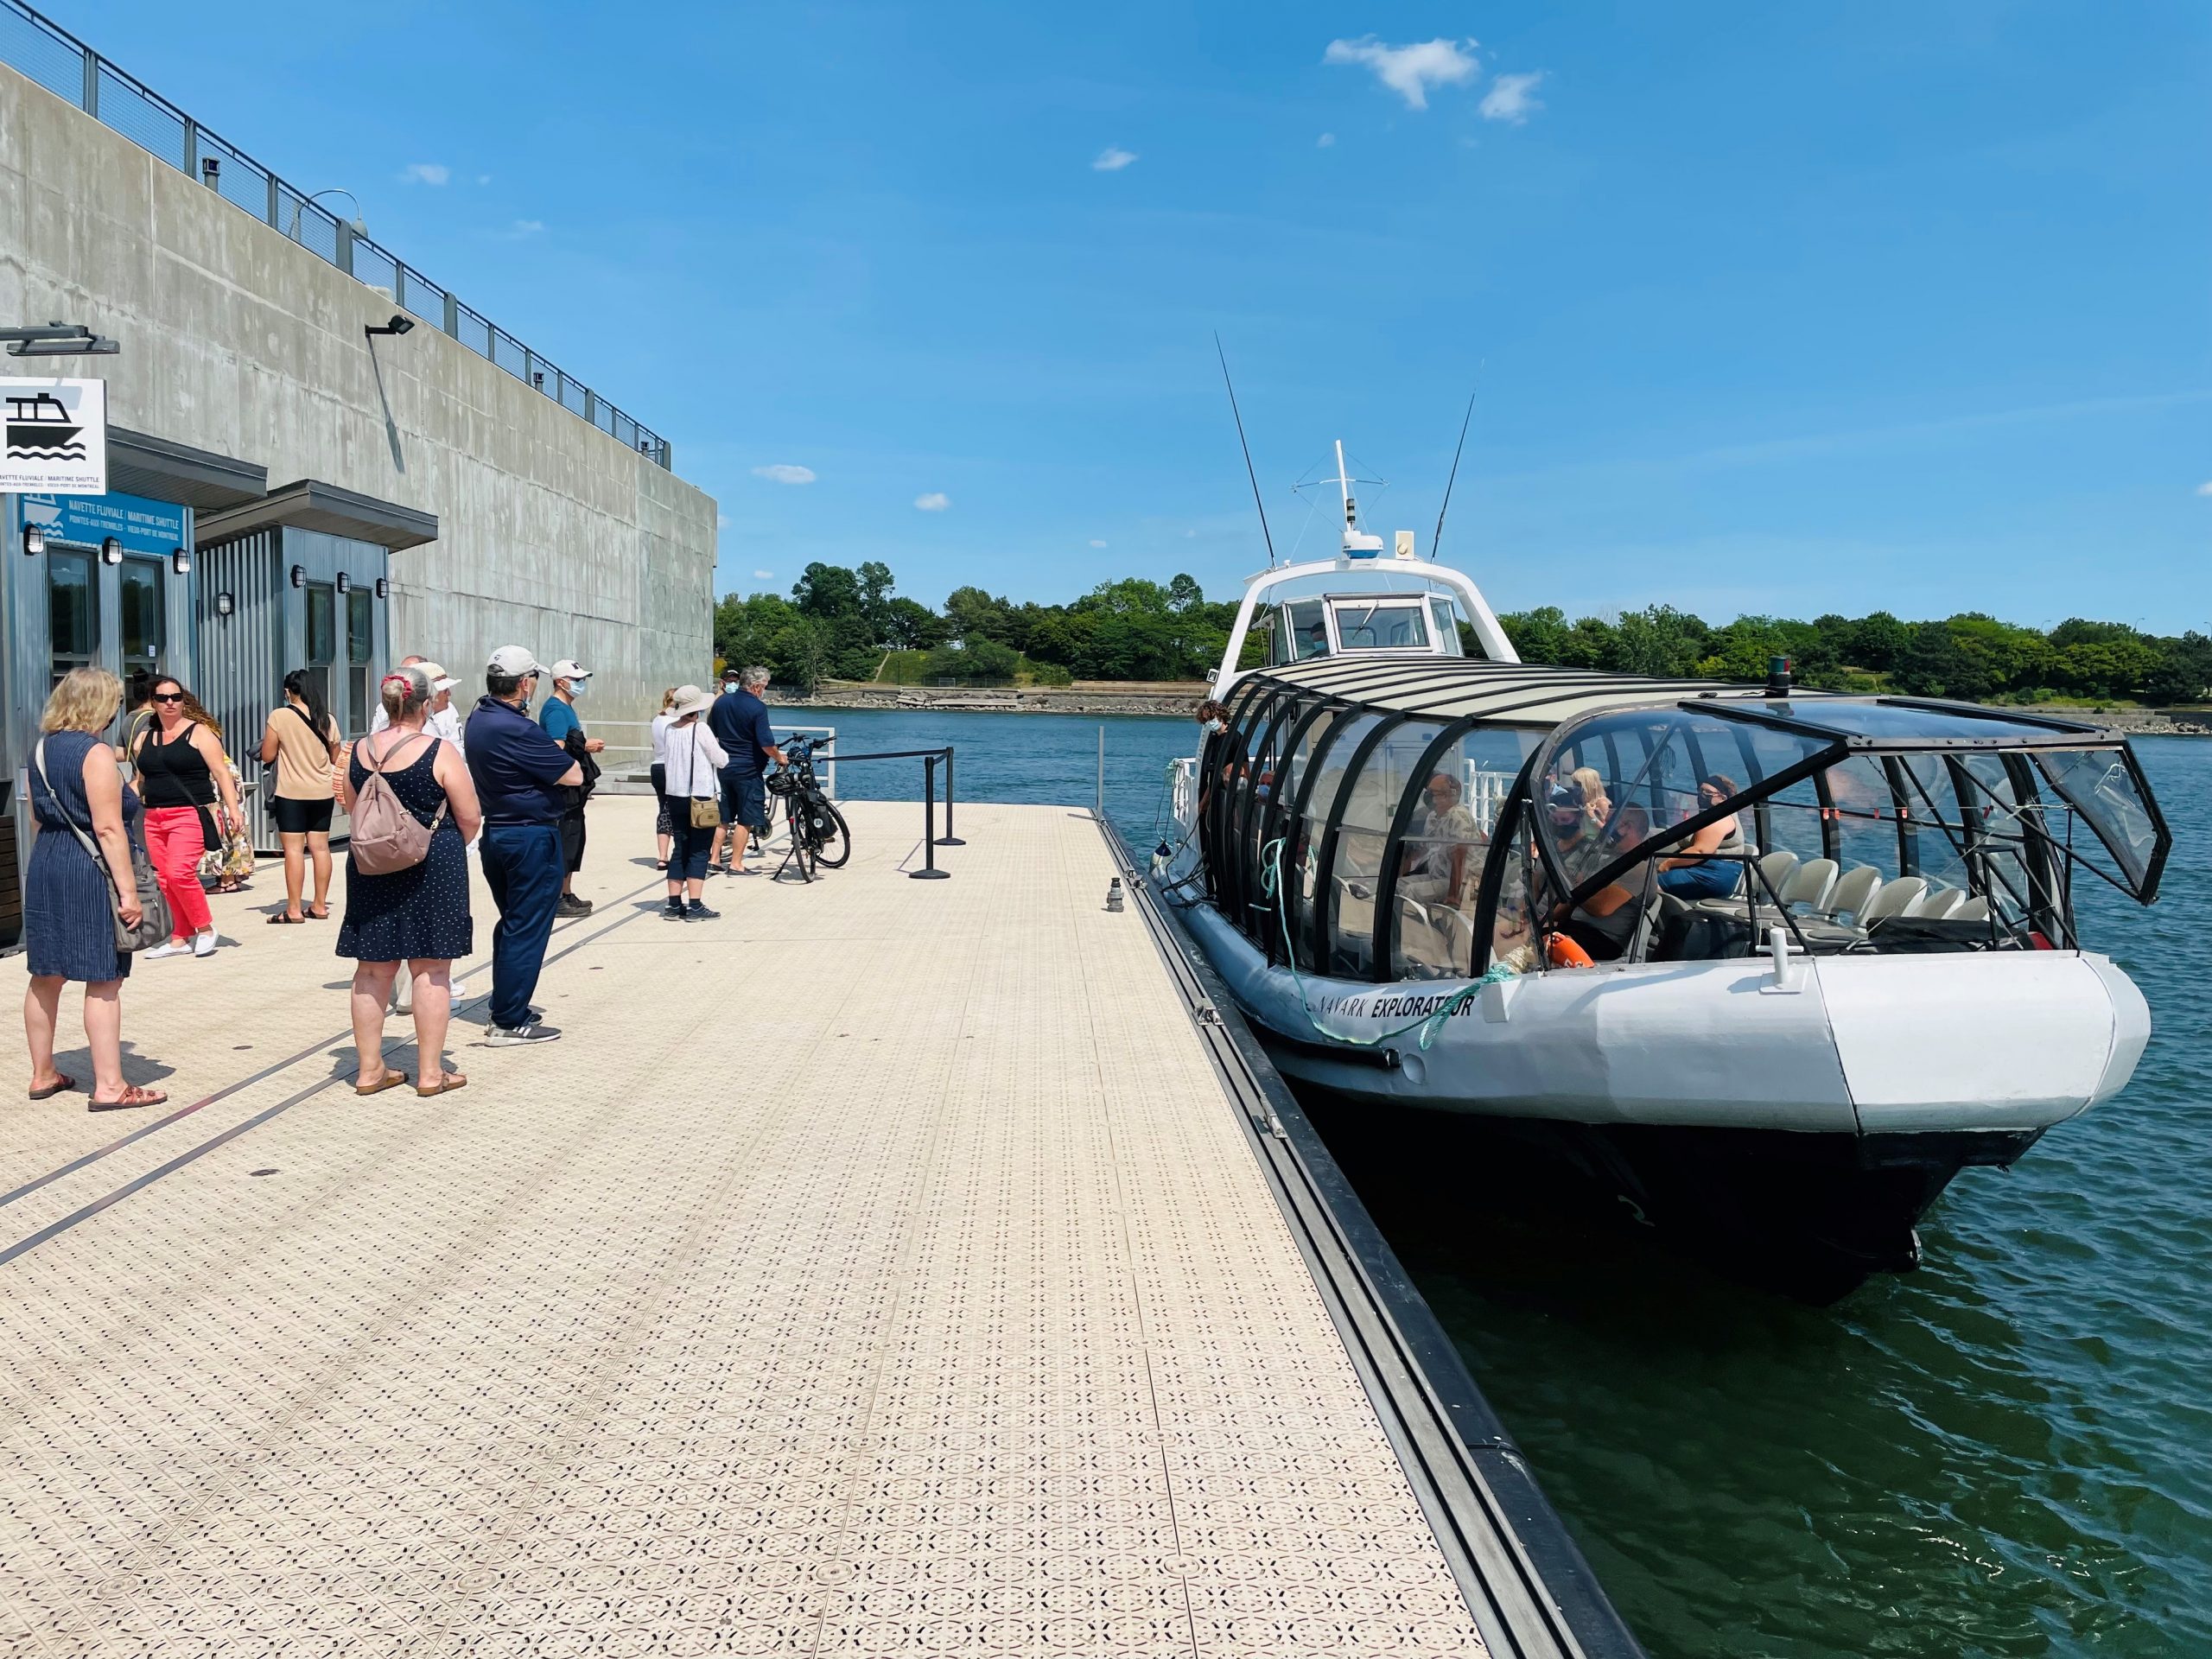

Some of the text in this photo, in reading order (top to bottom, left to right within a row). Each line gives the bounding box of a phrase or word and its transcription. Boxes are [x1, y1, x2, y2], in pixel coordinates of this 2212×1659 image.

[69, 500, 96, 514] NAVETTE
[97, 505, 124, 519] FLUVIALE
[128, 511, 156, 525] MARITIME
[156, 516, 179, 530] SHUTTLE
[1321, 995, 1369, 1017] NAVARK
